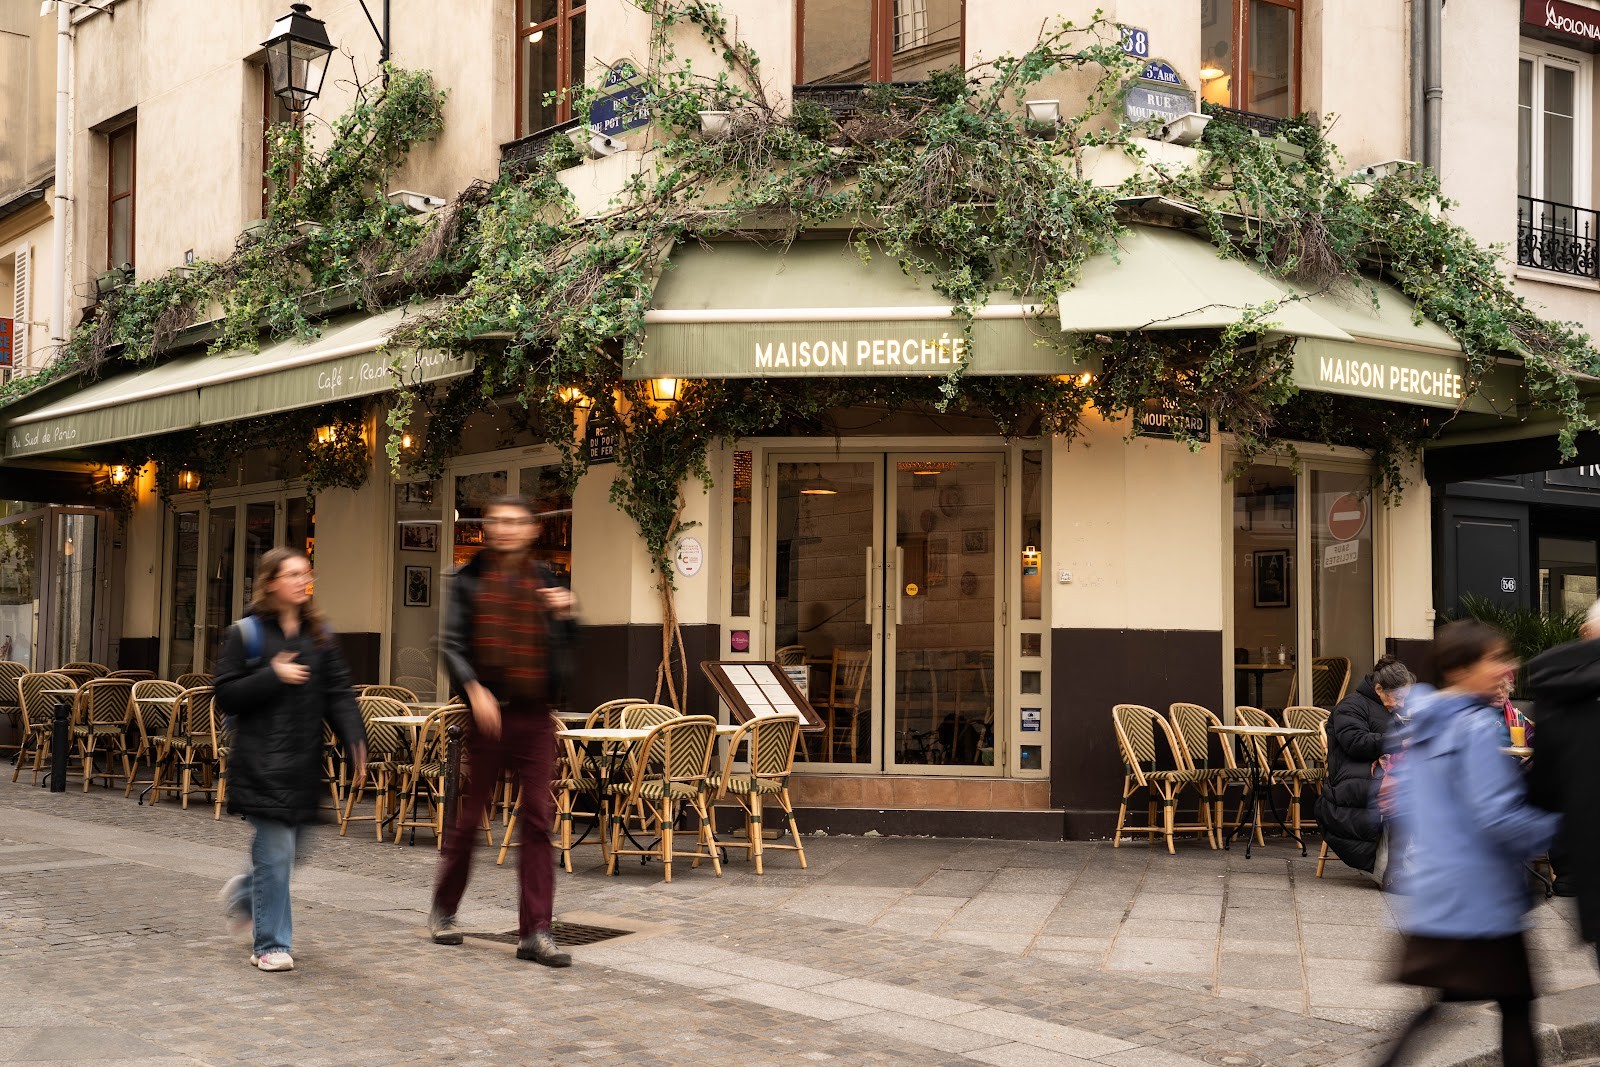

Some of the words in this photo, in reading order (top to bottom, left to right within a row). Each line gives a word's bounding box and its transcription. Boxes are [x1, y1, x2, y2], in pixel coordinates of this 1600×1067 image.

[1147, 94, 1171, 108] RUE
[604, 116, 619, 131] POT
[755, 341, 847, 367] MAISON
[857, 333, 964, 366] PERCHÉE
[318, 366, 342, 396] Café
[1320, 356, 1385, 389] MAISON
[1389, 365, 1461, 399] PERCHÉE
[1141, 412, 1203, 430] MOUFTARD
[12, 435, 21, 449] Au
[24, 428, 39, 447] Sud
[42, 427, 51, 444] de
[54, 426, 77, 442] Paris
[590, 438, 599, 448] DU
[601, 436, 614, 446] POT
[590, 448, 598, 457] DE
[601, 446, 613, 456] FER
[1503, 579, 1514, 591] 56
